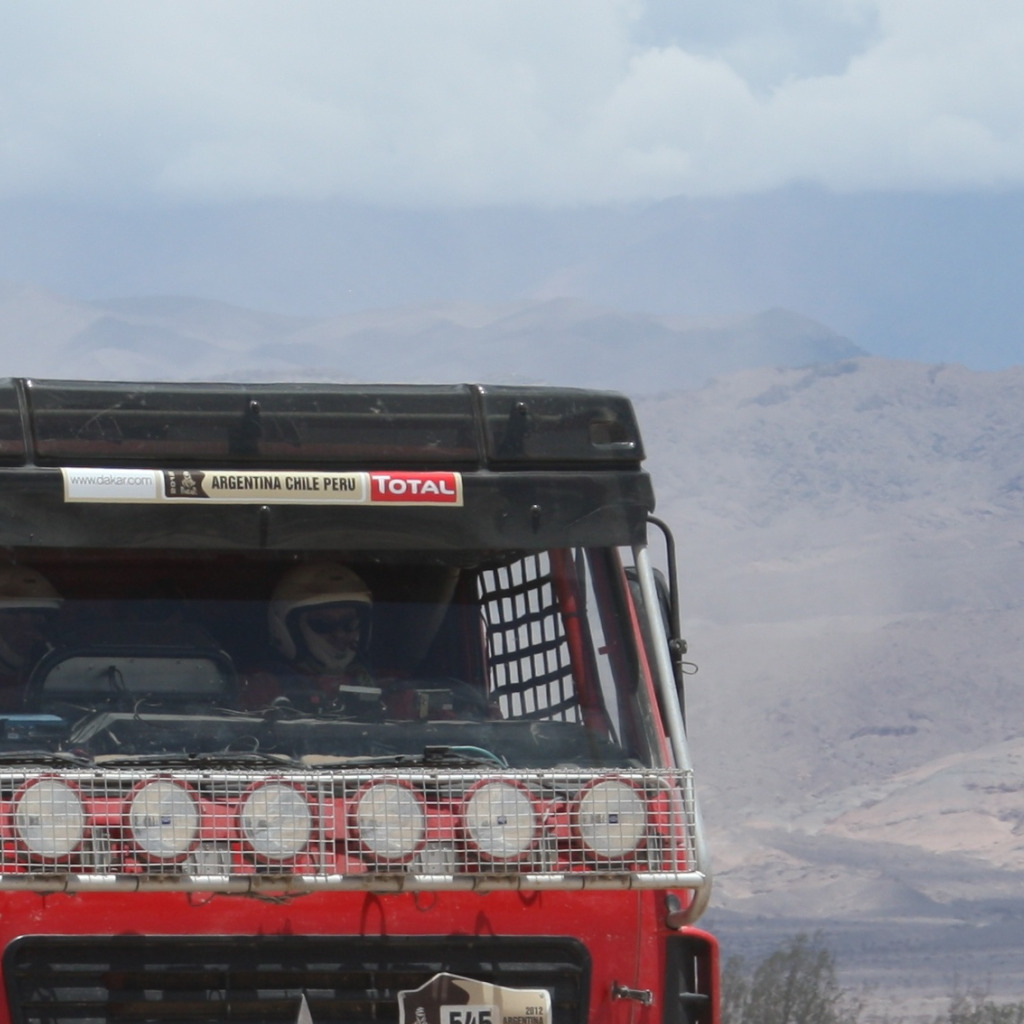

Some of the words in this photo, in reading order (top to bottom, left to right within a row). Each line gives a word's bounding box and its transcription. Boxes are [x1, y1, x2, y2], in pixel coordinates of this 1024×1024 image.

[70, 473, 153, 487] www.dakar.com
[211, 475, 282, 491] ARGENTINA
[285, 476, 321, 491] CHILE
[324, 477, 356, 491] PERU
[372, 474, 455, 495] TOTAL
[525, 1006, 544, 1016] 2012
